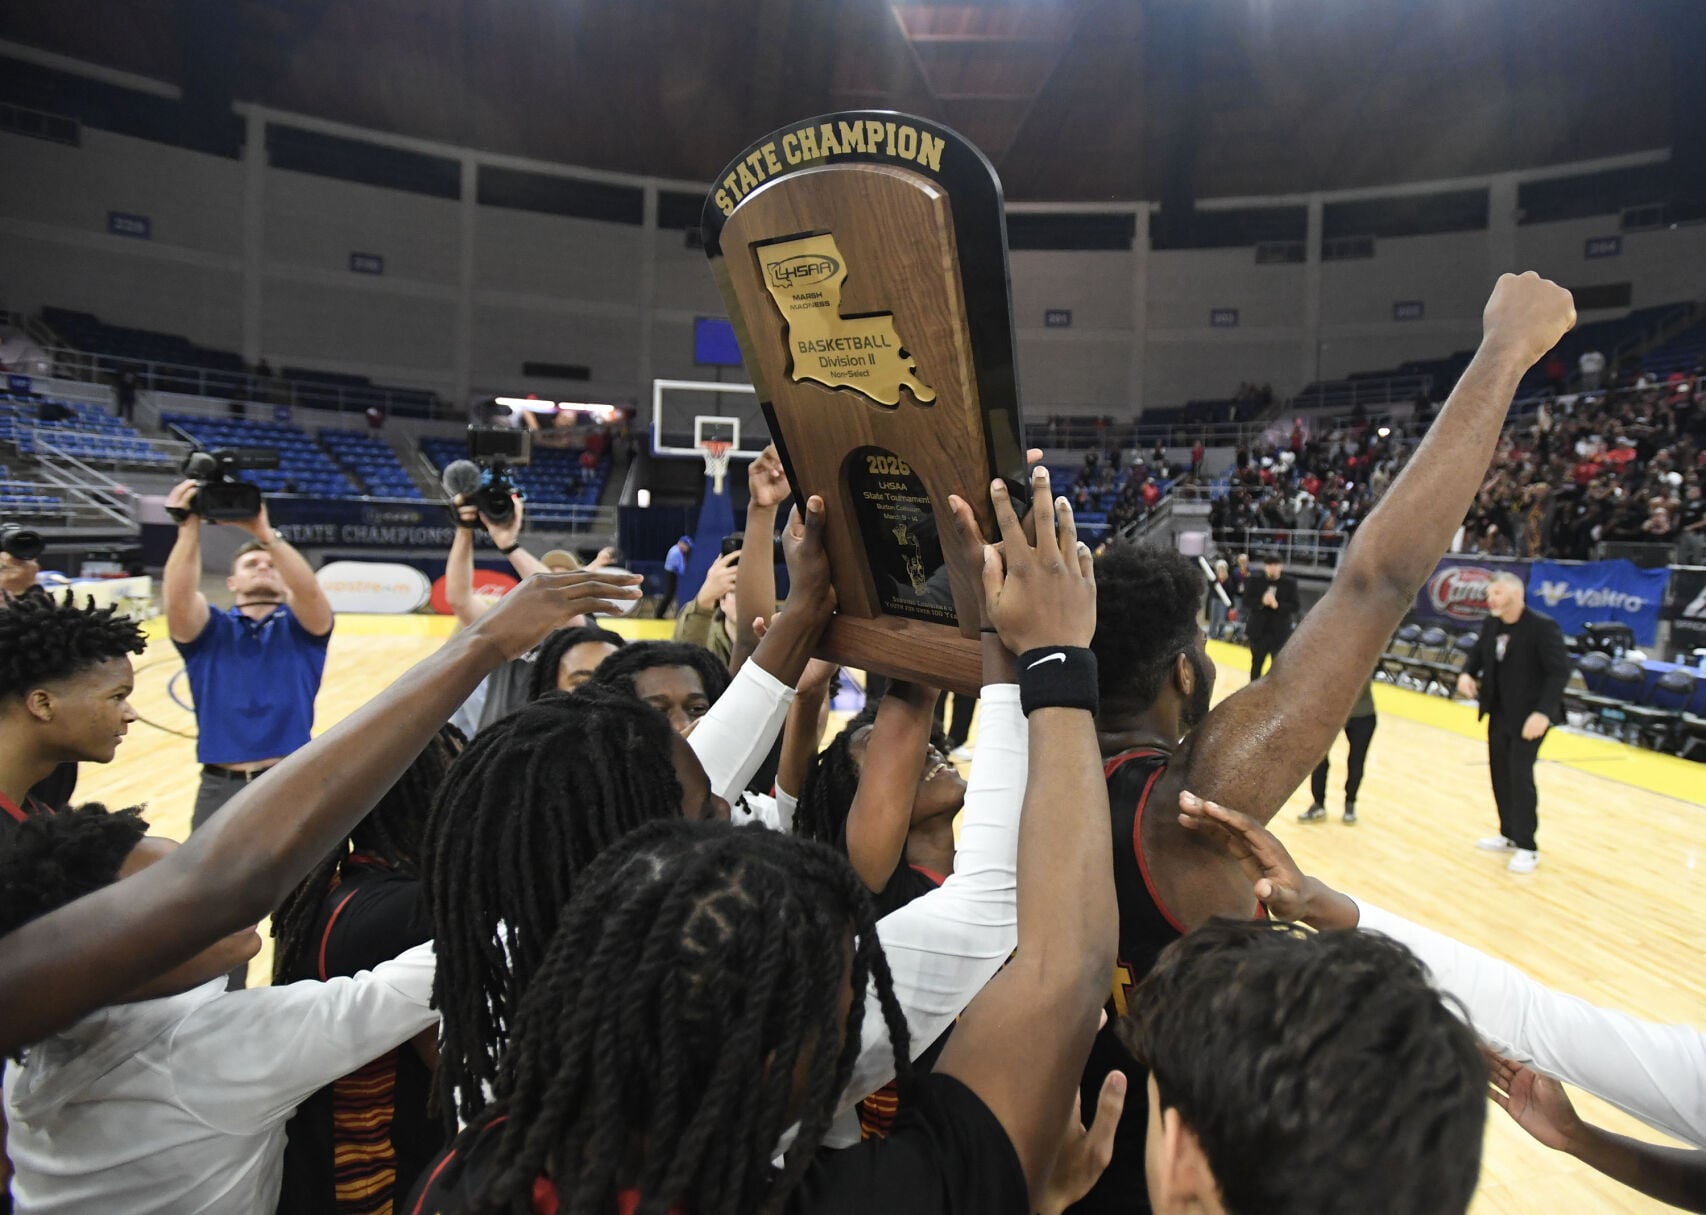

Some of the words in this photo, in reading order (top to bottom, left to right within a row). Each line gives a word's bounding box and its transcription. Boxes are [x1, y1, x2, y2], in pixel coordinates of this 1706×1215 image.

[715, 141, 783, 217] STATE
[782, 120, 945, 172] CHAMPION
[774, 261, 832, 280] LHSAA
[792, 292, 823, 301] MARSH
[789, 300, 831, 310] MADNESS
[798, 335, 891, 353] BASKETBALL
[818, 355, 866, 368] Division
[830, 370, 870, 379] Non-Select
[866, 455, 911, 476] 2026
[878, 481, 908, 491] LHSAA
[863, 491, 884, 500] State
[884, 492, 931, 505] Tournament
[281, 524, 337, 542] STATE
